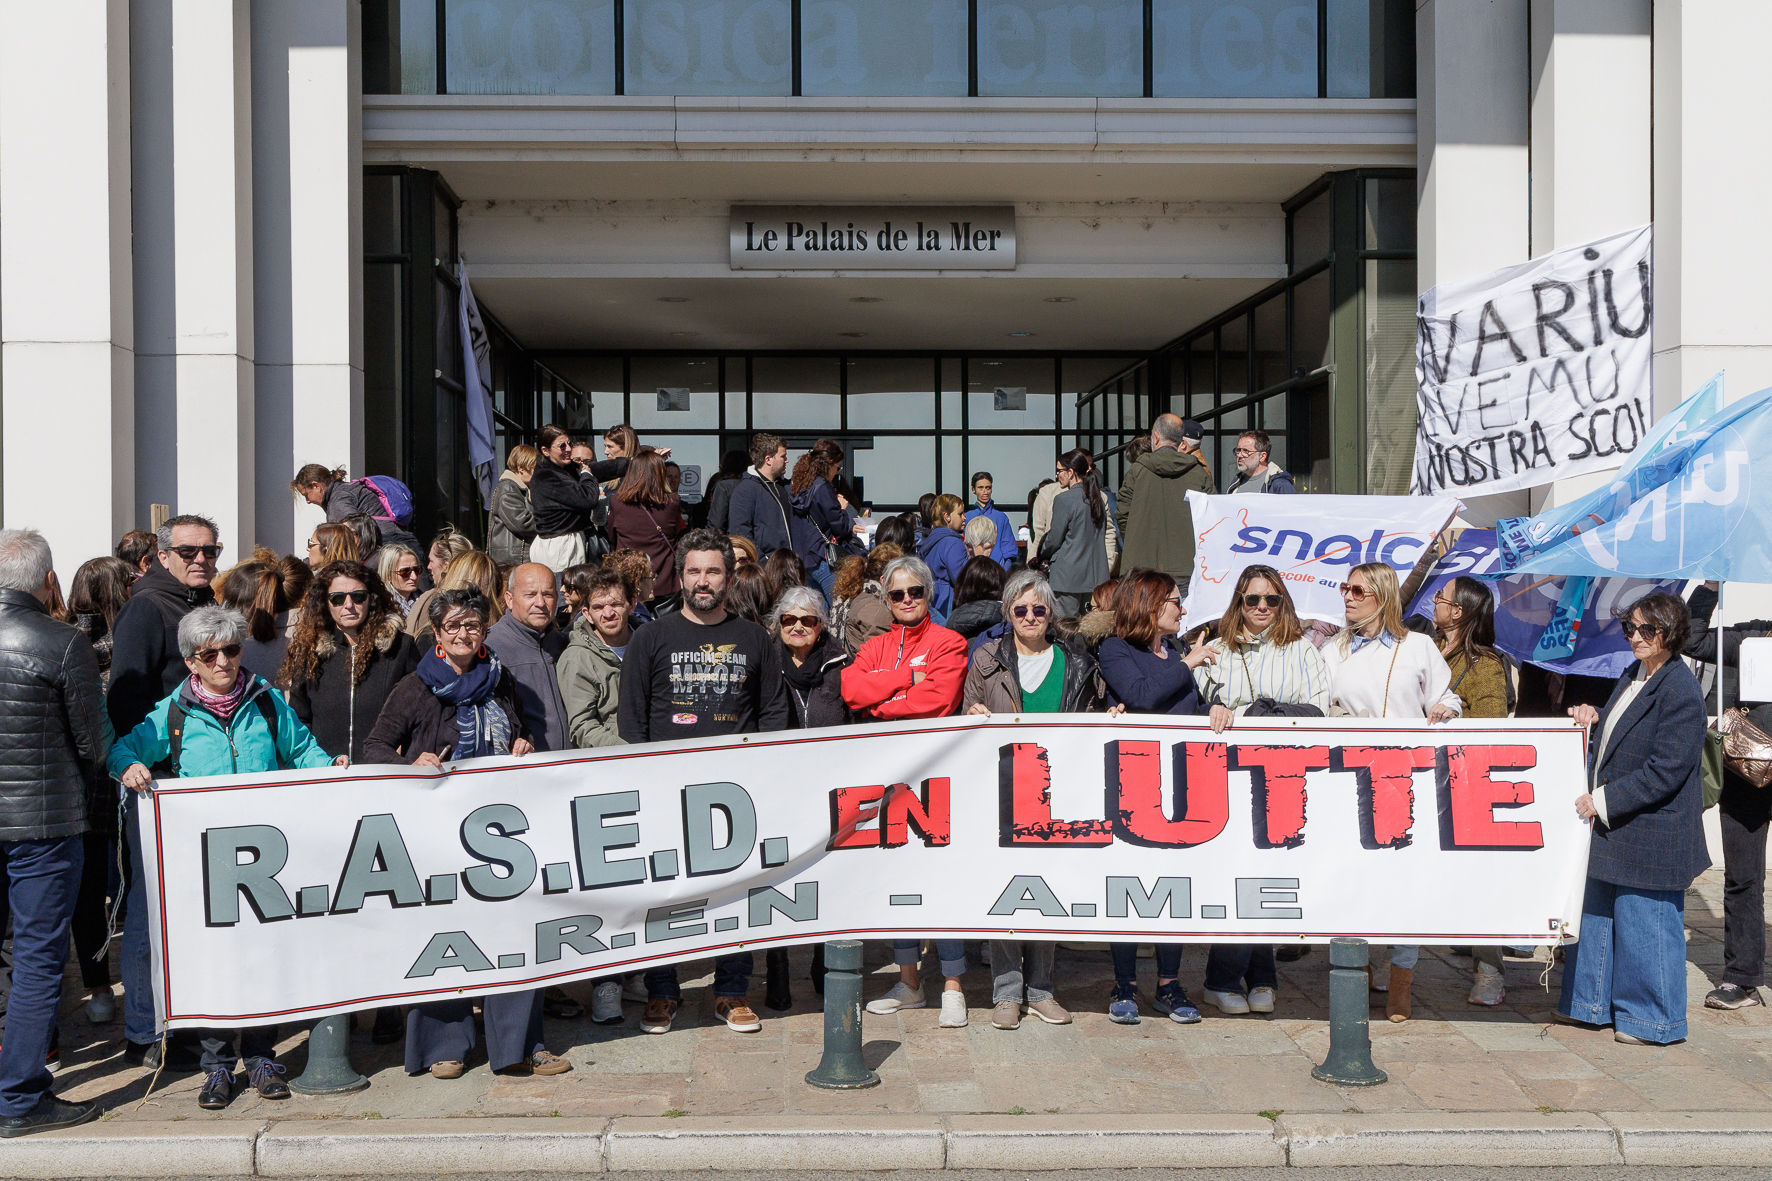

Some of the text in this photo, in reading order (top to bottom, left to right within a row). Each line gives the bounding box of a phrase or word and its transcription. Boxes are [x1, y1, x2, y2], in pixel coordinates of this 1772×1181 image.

[745, 221, 1001, 252] Le Palais de la Mer
[1230, 526, 1425, 571] snalc
[1318, 578, 1338, 589] au
[671, 651, 747, 666] OFFICIAL TEAM
[203, 739, 1545, 927] R.A.S.E.D. EN LUTTE
[404, 881, 820, 979] A.R.E.N
[987, 874, 1303, 920] A.M.E
